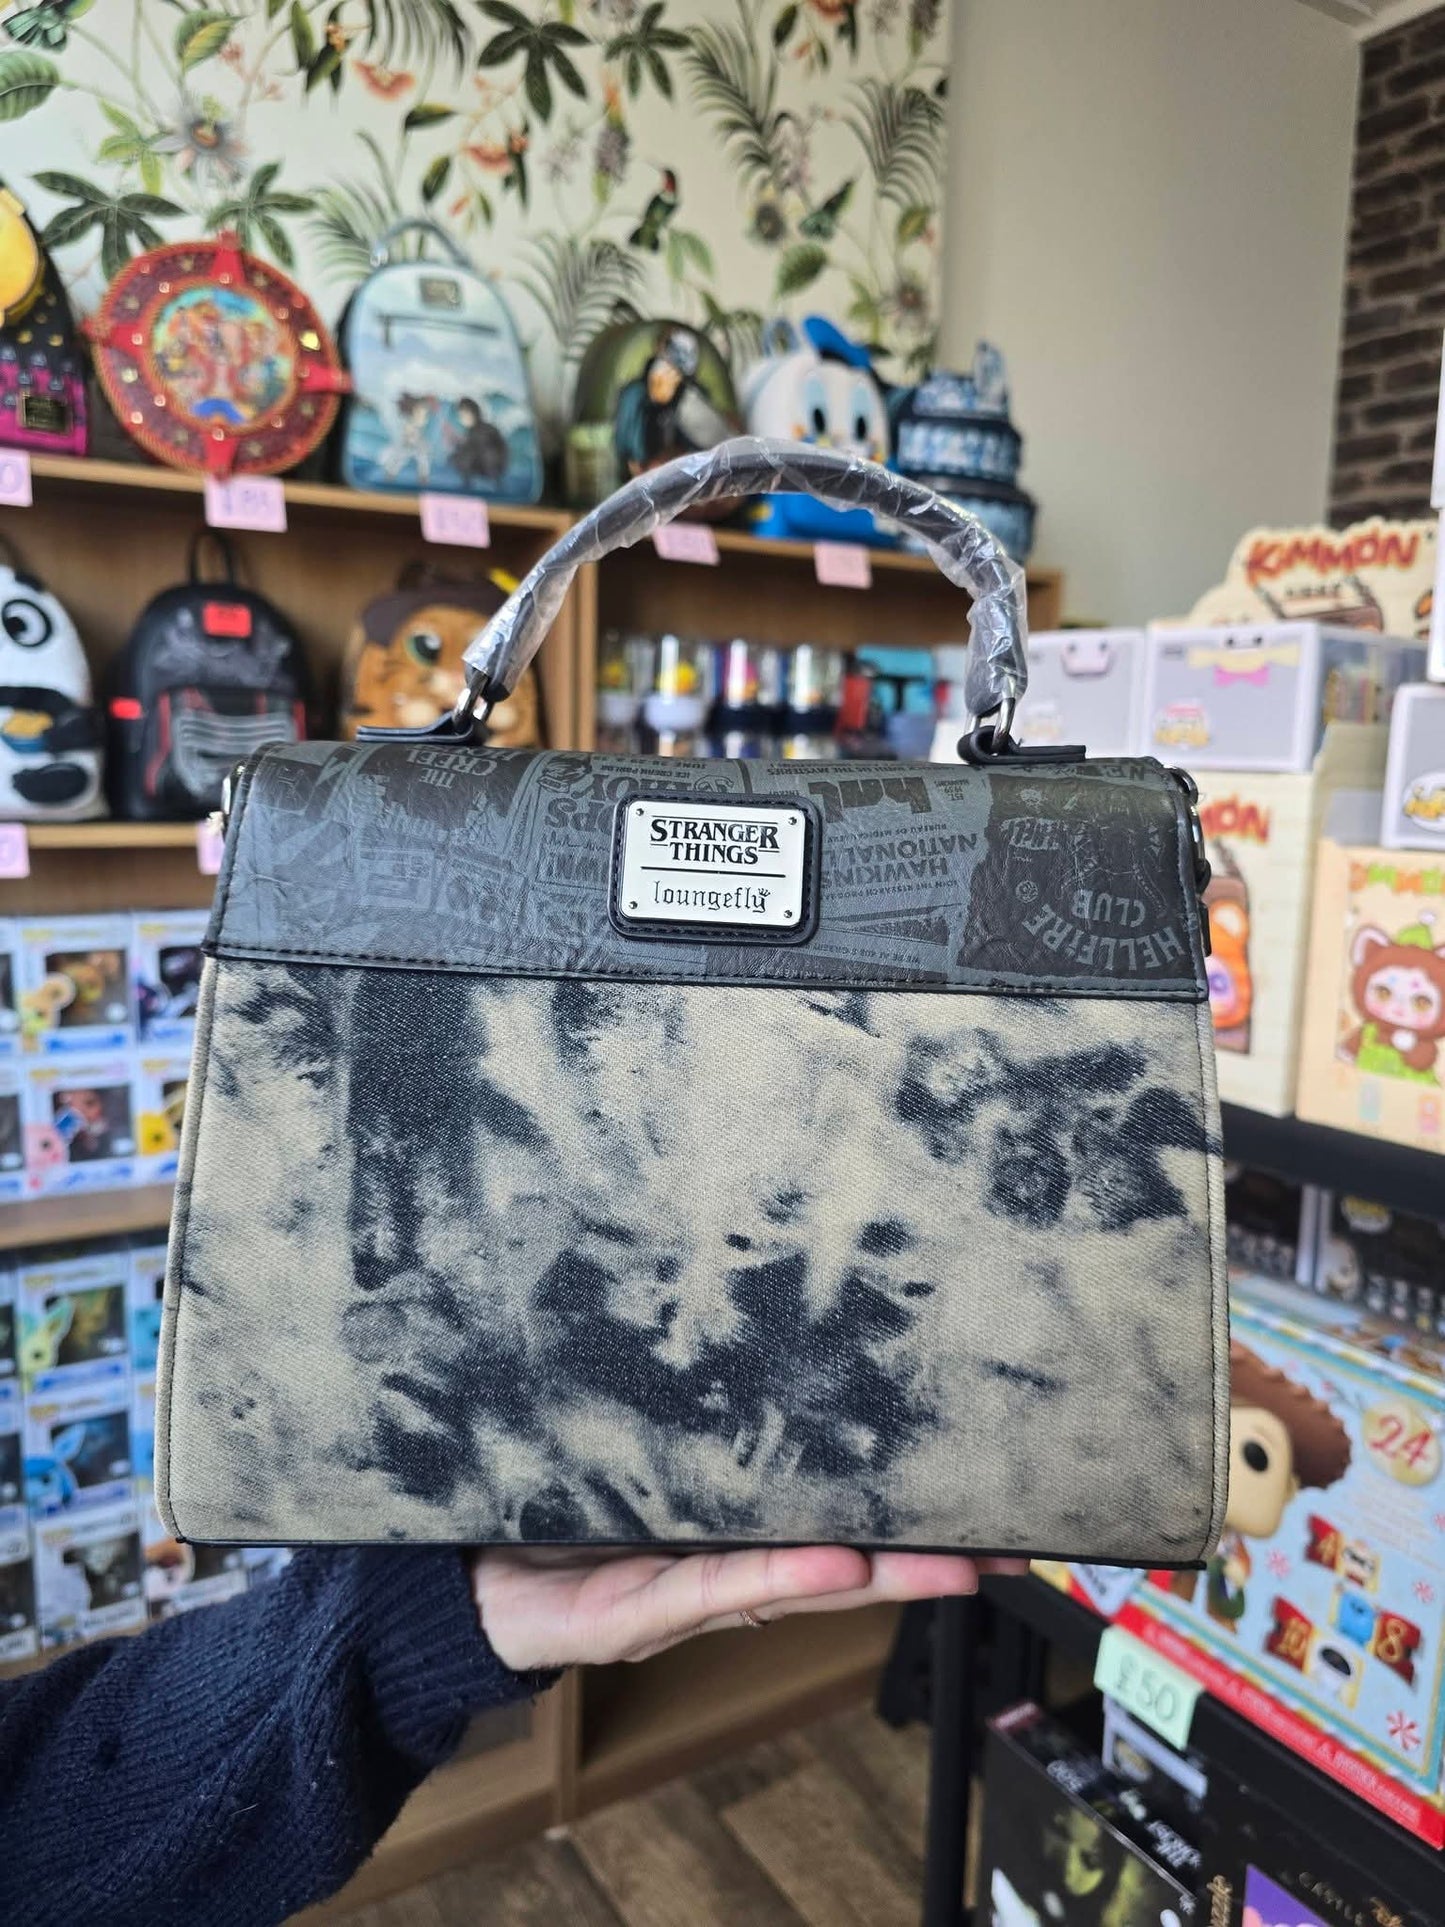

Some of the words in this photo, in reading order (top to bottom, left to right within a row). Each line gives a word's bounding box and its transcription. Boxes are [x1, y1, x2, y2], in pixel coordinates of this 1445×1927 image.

[405, 749, 498, 777] CREEL
[640, 768, 672, 778] CREAM
[675, 770, 691, 780] ICE
[767, 766, 829, 777] MYSTERIES
[418, 768, 457, 791] THE
[650, 818, 780, 850] STRANGER
[669, 841, 760, 866] THINGS
[844, 833, 978, 867] NATIONAL
[653, 880, 770, 914] loungefly
[1071, 888, 1146, 928] CLUB
[1369, 1414, 1433, 1467] 24
[1377, 1617, 1408, 1664] 8
